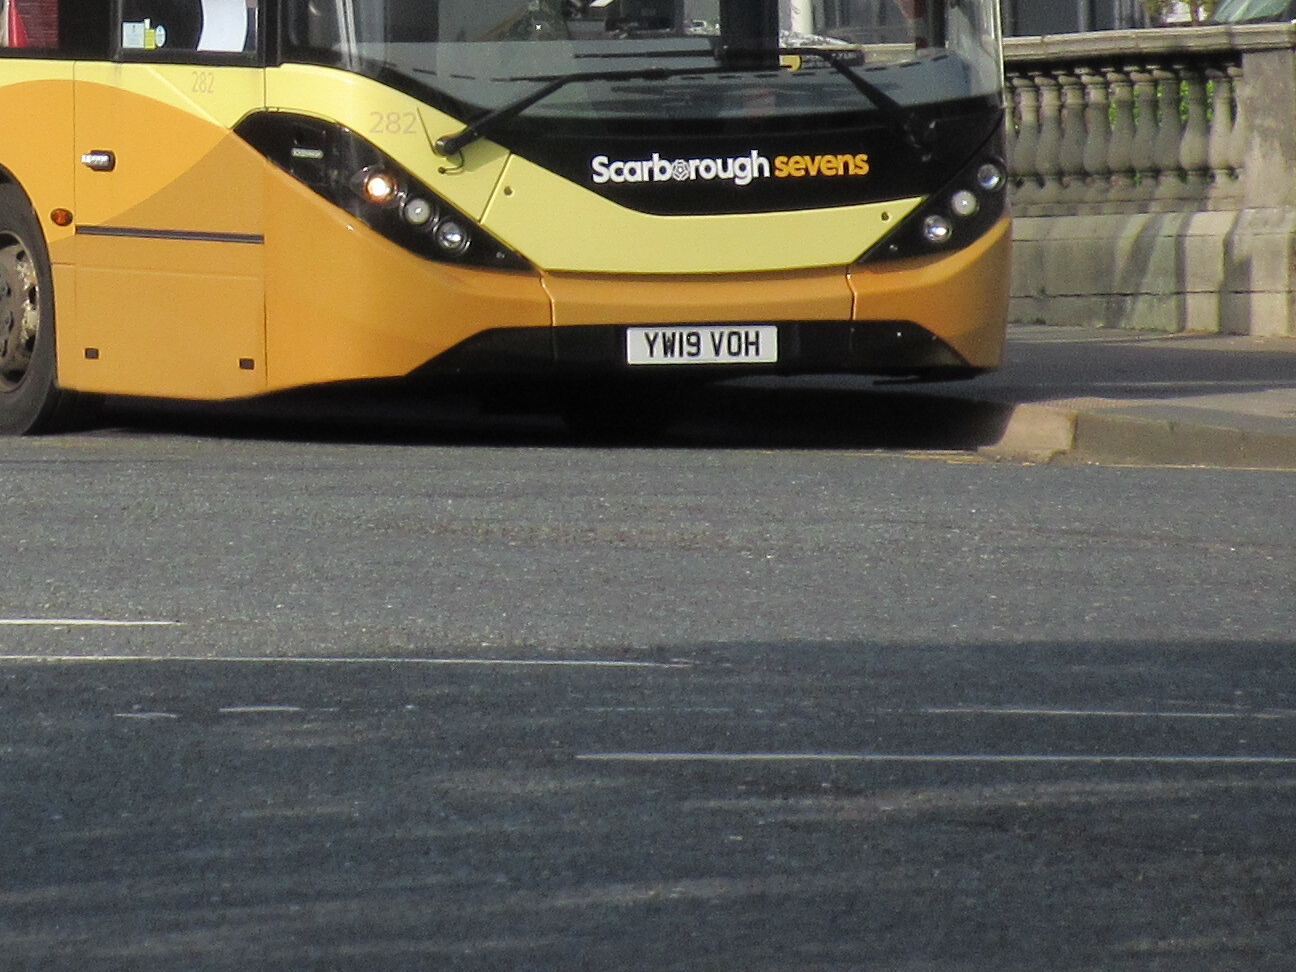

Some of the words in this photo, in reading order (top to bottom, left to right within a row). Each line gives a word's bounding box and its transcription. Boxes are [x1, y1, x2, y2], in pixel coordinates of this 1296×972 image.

[369, 111, 417, 134] 282
[591, 150, 770, 185] Scarborough
[774, 153, 870, 178] sevens
[644, 331, 701, 358] YW19
[710, 330, 760, 358] VOH
